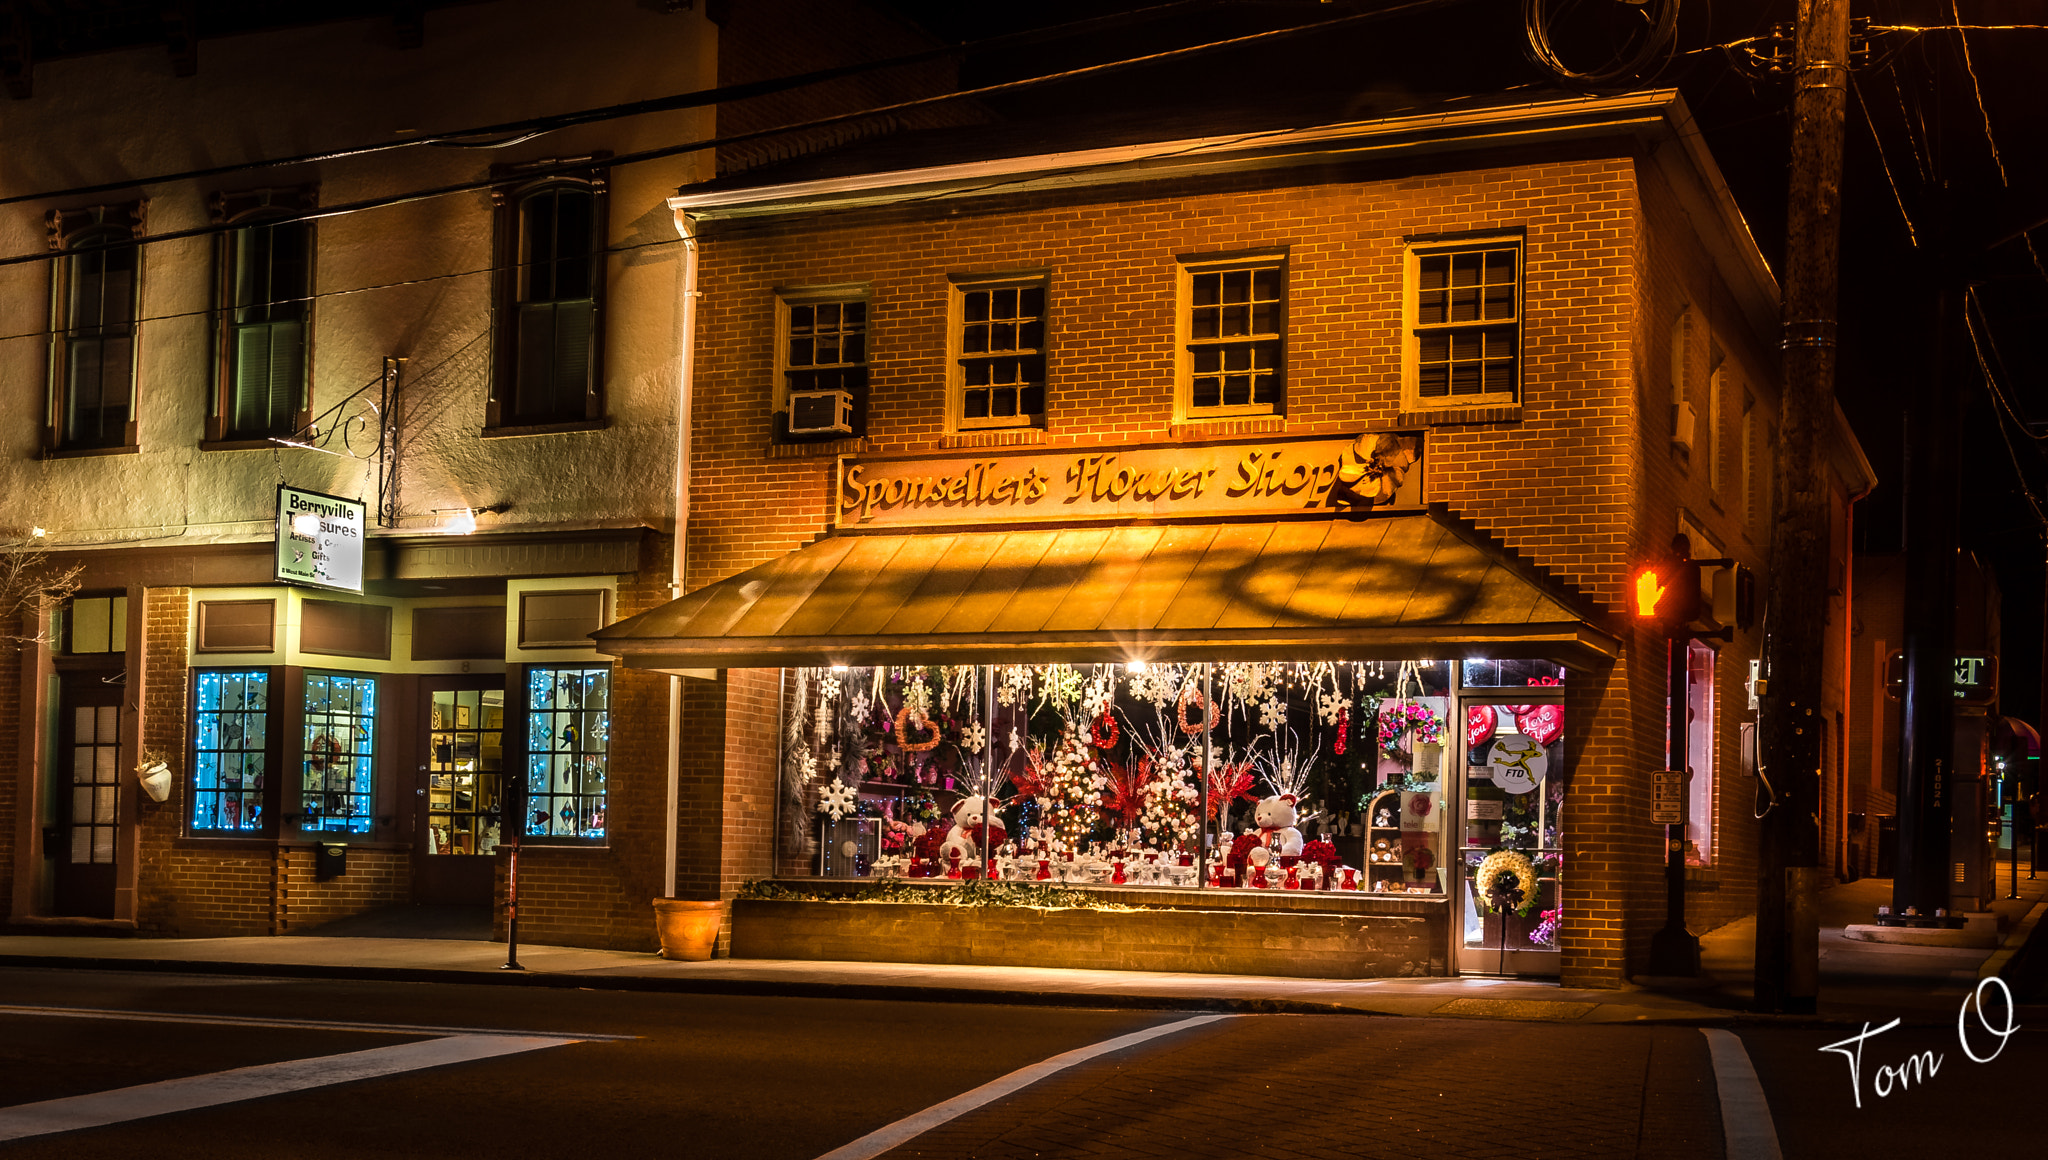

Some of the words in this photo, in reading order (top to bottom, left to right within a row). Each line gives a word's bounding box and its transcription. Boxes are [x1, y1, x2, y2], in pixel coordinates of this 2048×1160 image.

[843, 460, 1050, 520] Sponseller's
[1066, 453, 1218, 502] Flower
[1228, 447, 1342, 508] Shop
[289, 493, 354, 520] Berryville
[286, 510, 357, 538] Tsures
[289, 532, 316, 544] Artists
[311, 551, 330, 562] Gifts
[1520, 711, 1554, 734] Love
[1529, 721, 1556, 743] You
[1505, 768, 1525, 778] FTD
